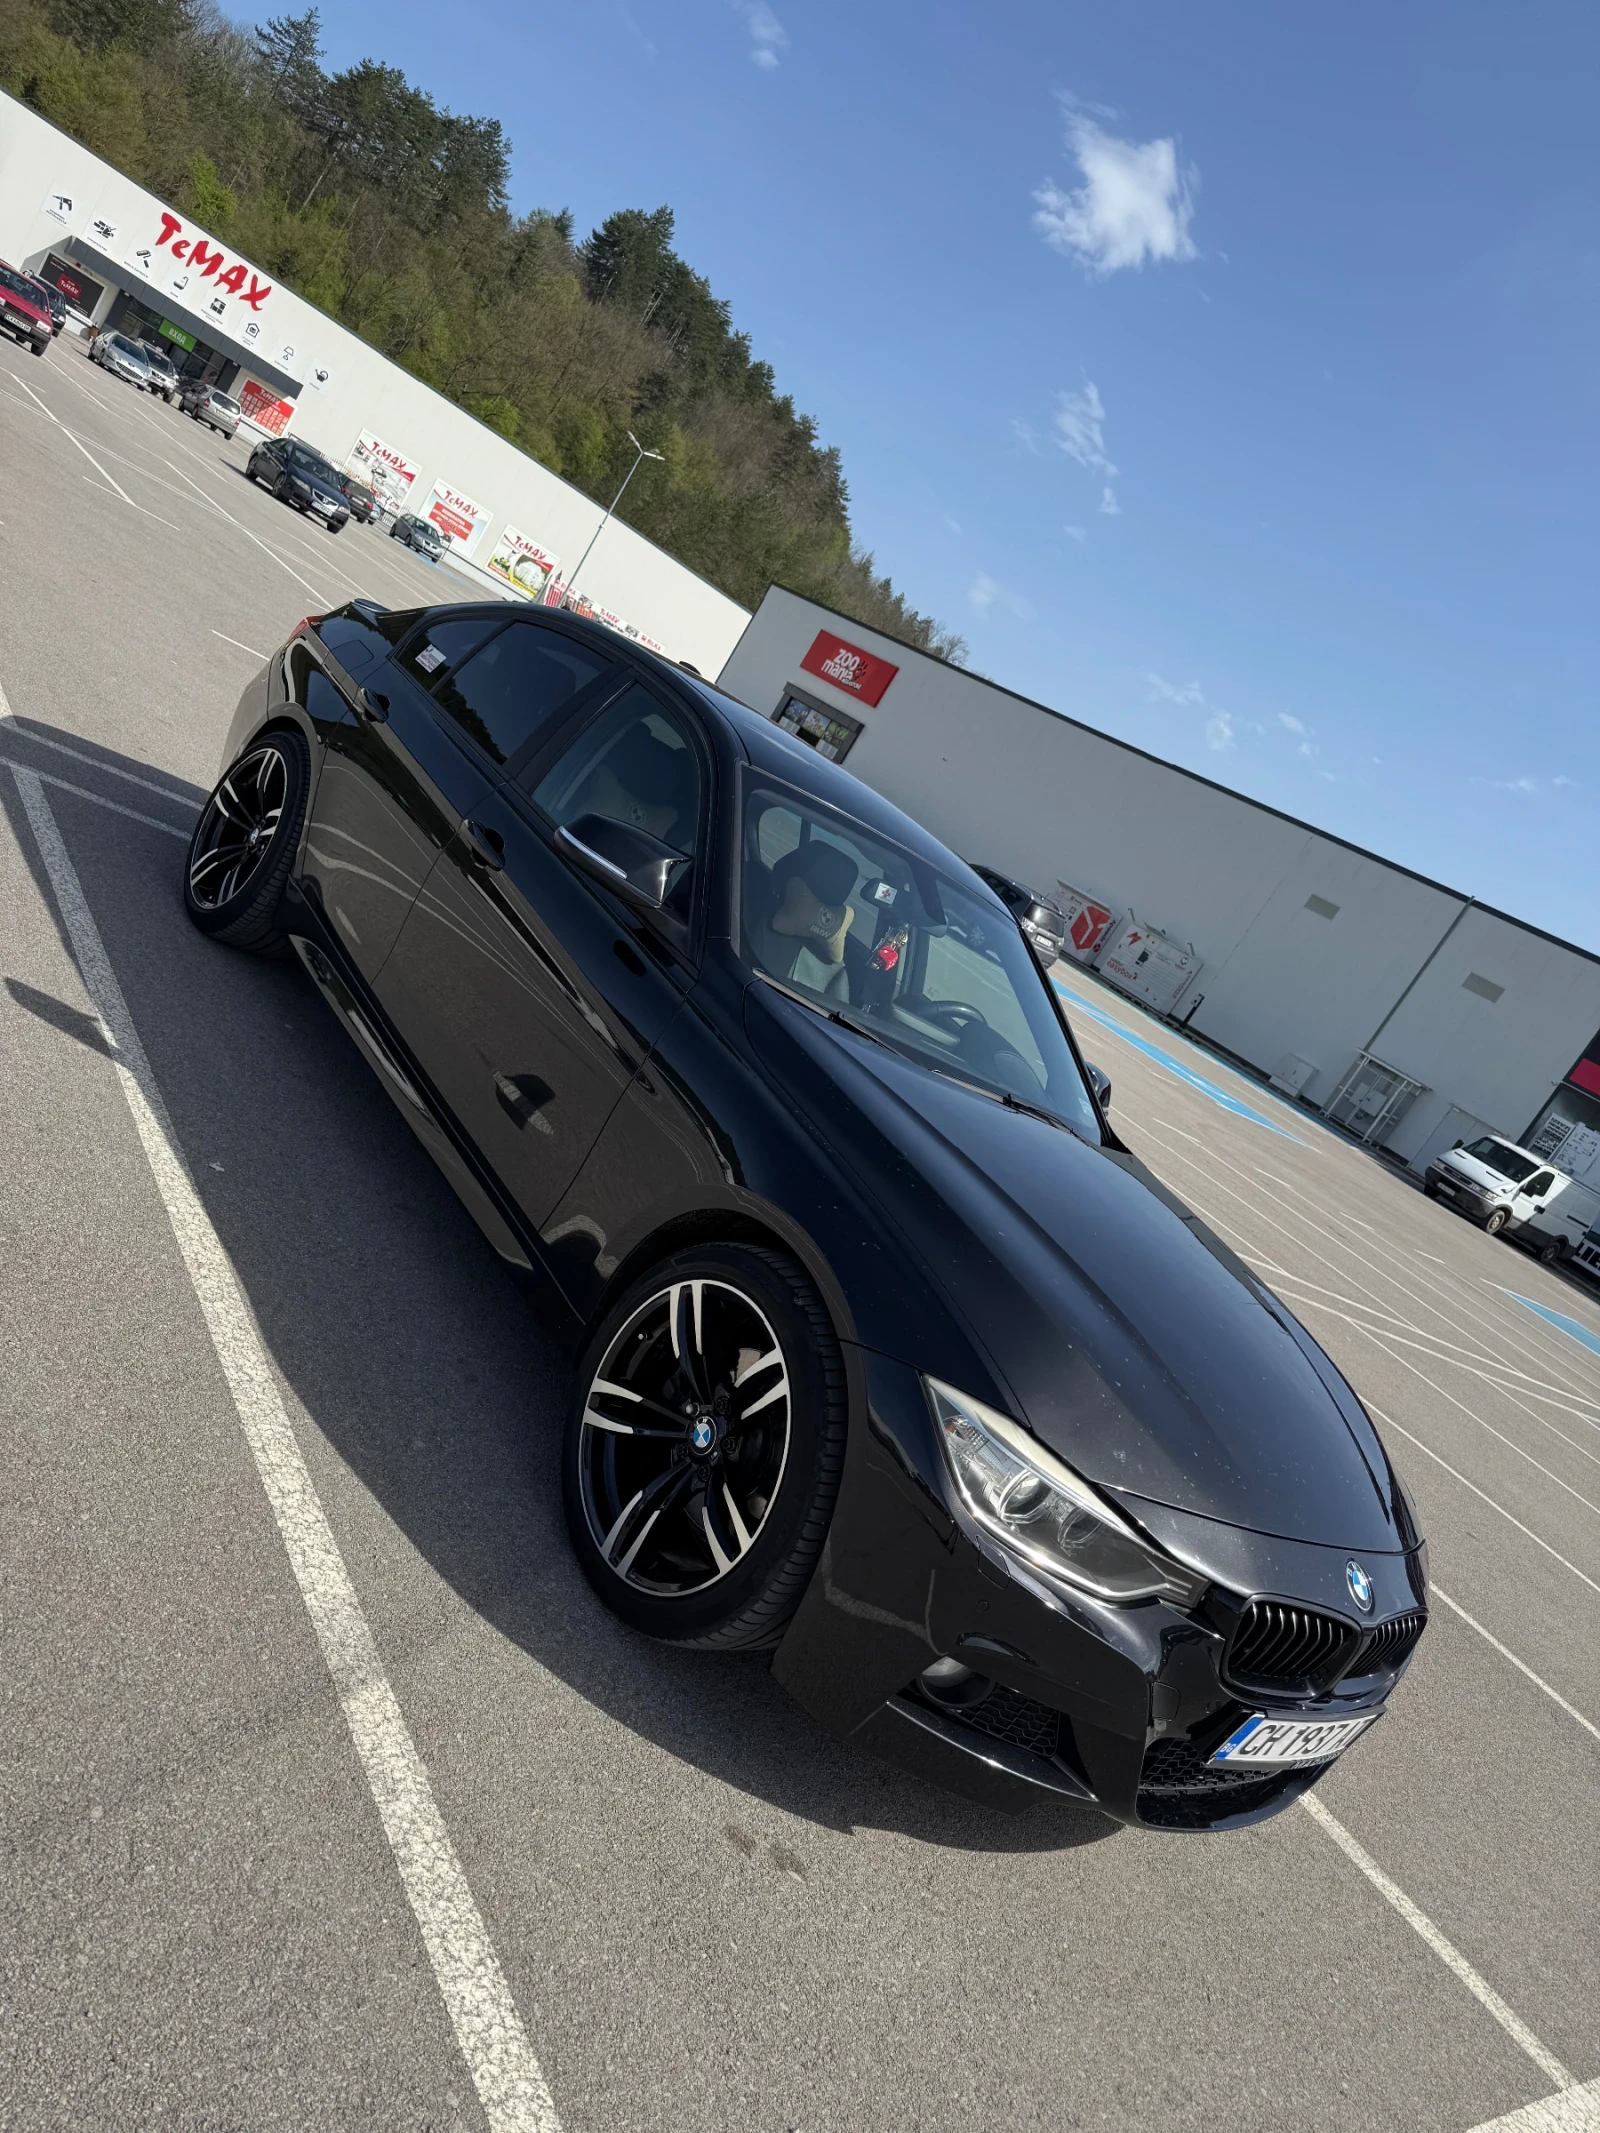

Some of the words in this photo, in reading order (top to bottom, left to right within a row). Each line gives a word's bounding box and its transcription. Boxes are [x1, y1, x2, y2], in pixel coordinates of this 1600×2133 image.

[155, 212, 272, 311] TeMAX
[168, 327, 187, 345] ВХОД
[820, 659, 854, 681] mania
[810, 925, 831, 938] BMW
[1099, 919, 1116, 942] speedy
[1106, 960, 1133, 980] easybox
[1220, 1743, 1237, 1753] BG
